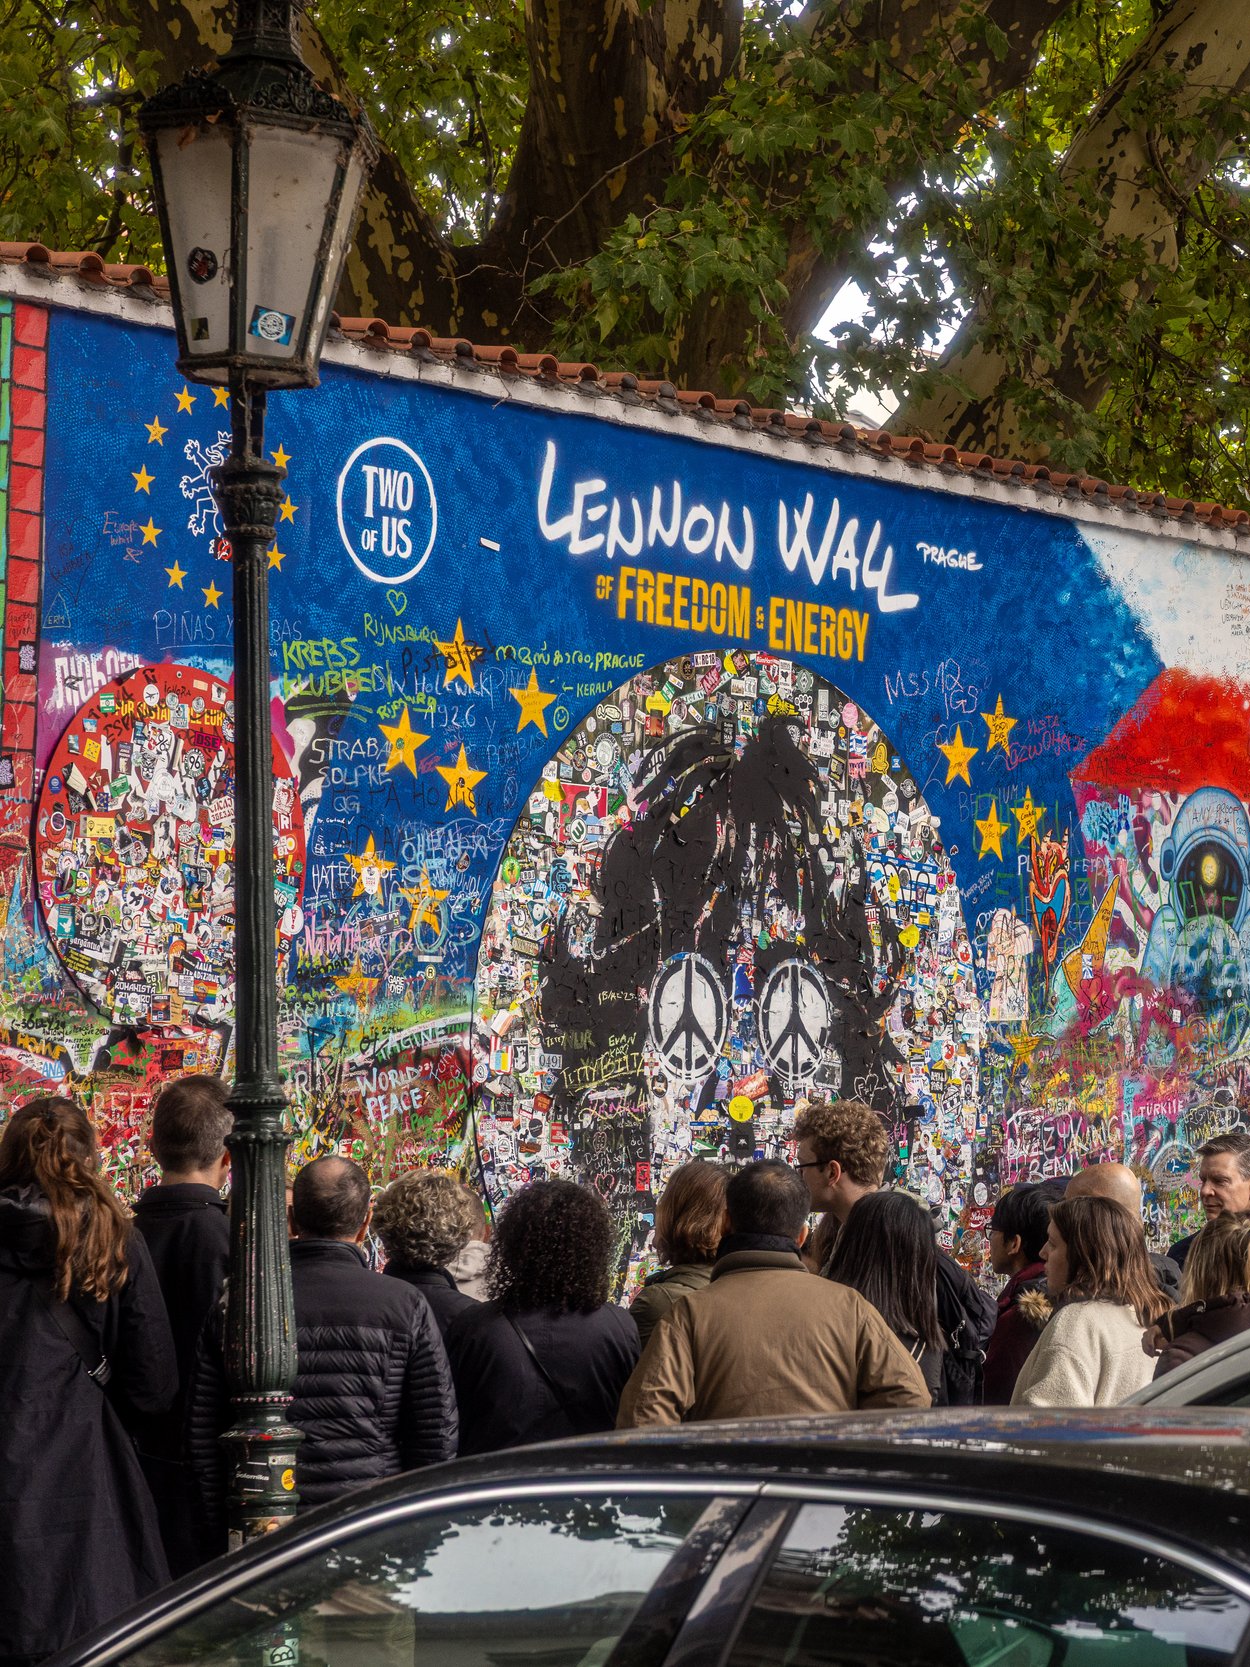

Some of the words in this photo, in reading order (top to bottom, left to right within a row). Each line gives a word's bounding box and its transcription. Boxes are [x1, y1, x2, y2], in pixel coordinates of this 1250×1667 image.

[361, 464, 414, 519] TWO
[361, 529, 378, 551] OF
[381, 516, 413, 560] US
[537, 440, 753, 570] LENNON
[779, 492, 919, 613] WALL
[916, 542, 983, 571] PRAGUE
[596, 572, 614, 600] OF
[617, 565, 751, 640] FREEDOM
[769, 596, 870, 662] ENERGY
[283, 637, 361, 670] KREBS
[595, 652, 645, 672] PRAGUE
[576, 681, 613, 697] KERALA
[424, 703, 475, 728] 1926
[189, 756, 201, 769] 96
[608, 1032, 637, 1047] EVAN
[42, 1060, 65, 1078] ANA
[356, 1064, 420, 1097] WORLD
[366, 1087, 423, 1121] PEACE
